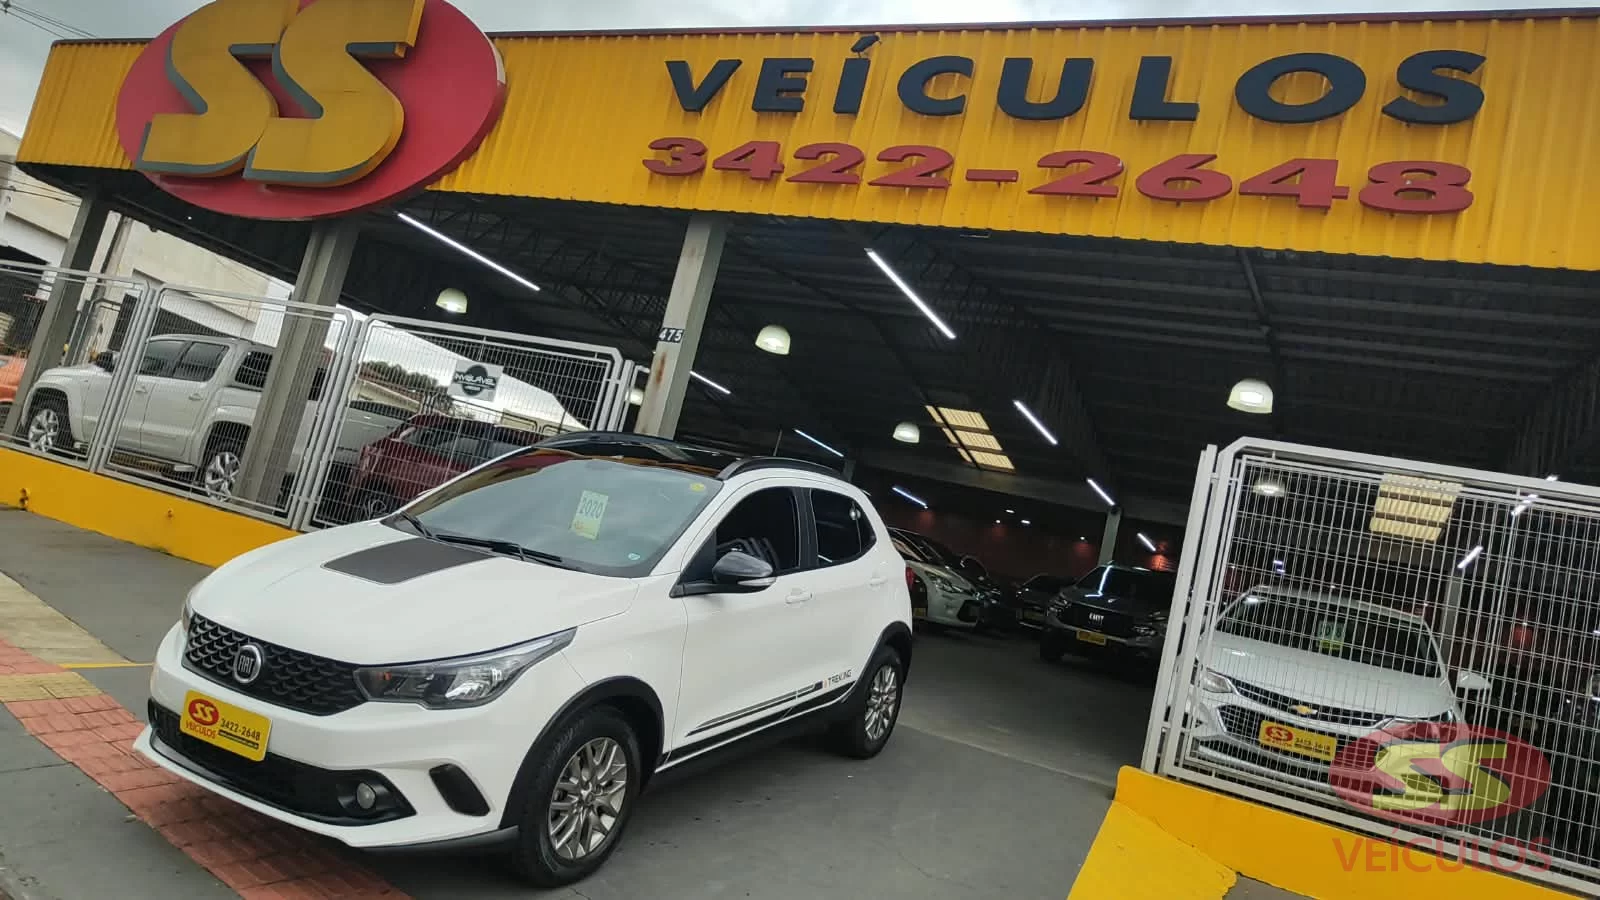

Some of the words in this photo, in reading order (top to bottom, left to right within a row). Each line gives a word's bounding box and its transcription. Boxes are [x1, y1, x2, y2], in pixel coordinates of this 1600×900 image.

[135, 0, 426, 188] SS
[642, 136, 1474, 214] 3422-2648
[658, 328, 684, 342] 475
[238, 655, 255, 673] FIAT
[193, 702, 216, 722] SS
[220, 718, 261, 741] 3422-2648
